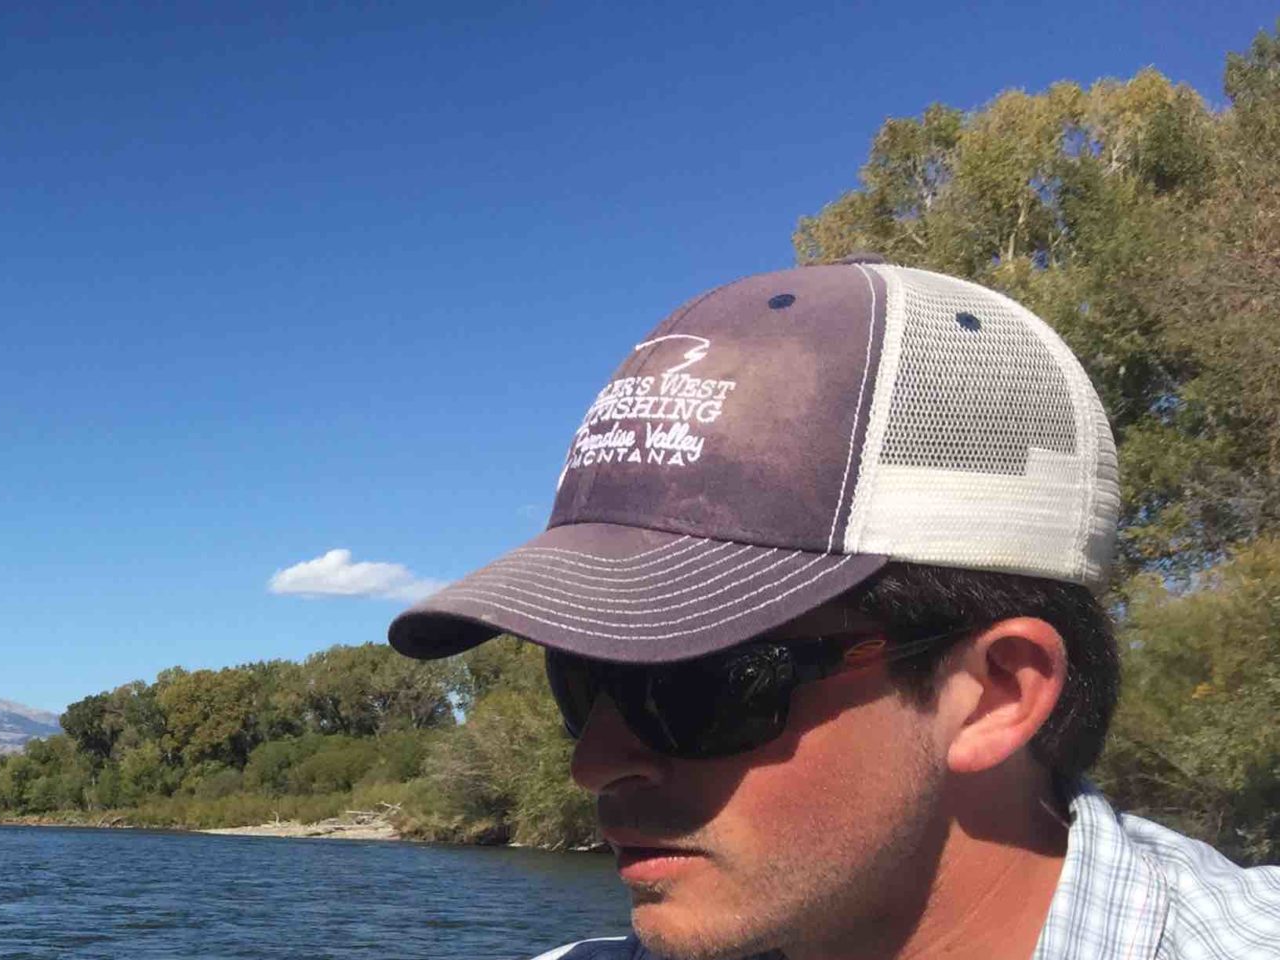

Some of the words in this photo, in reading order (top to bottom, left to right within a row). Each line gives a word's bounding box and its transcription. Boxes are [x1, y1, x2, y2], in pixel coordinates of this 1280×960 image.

[661, 373, 736, 400] WEST
[585, 396, 723, 425] FISHING
[575, 421, 636, 451] Paradise
[645, 422, 705, 462] Valley
[571, 447, 686, 468] MONTANA
